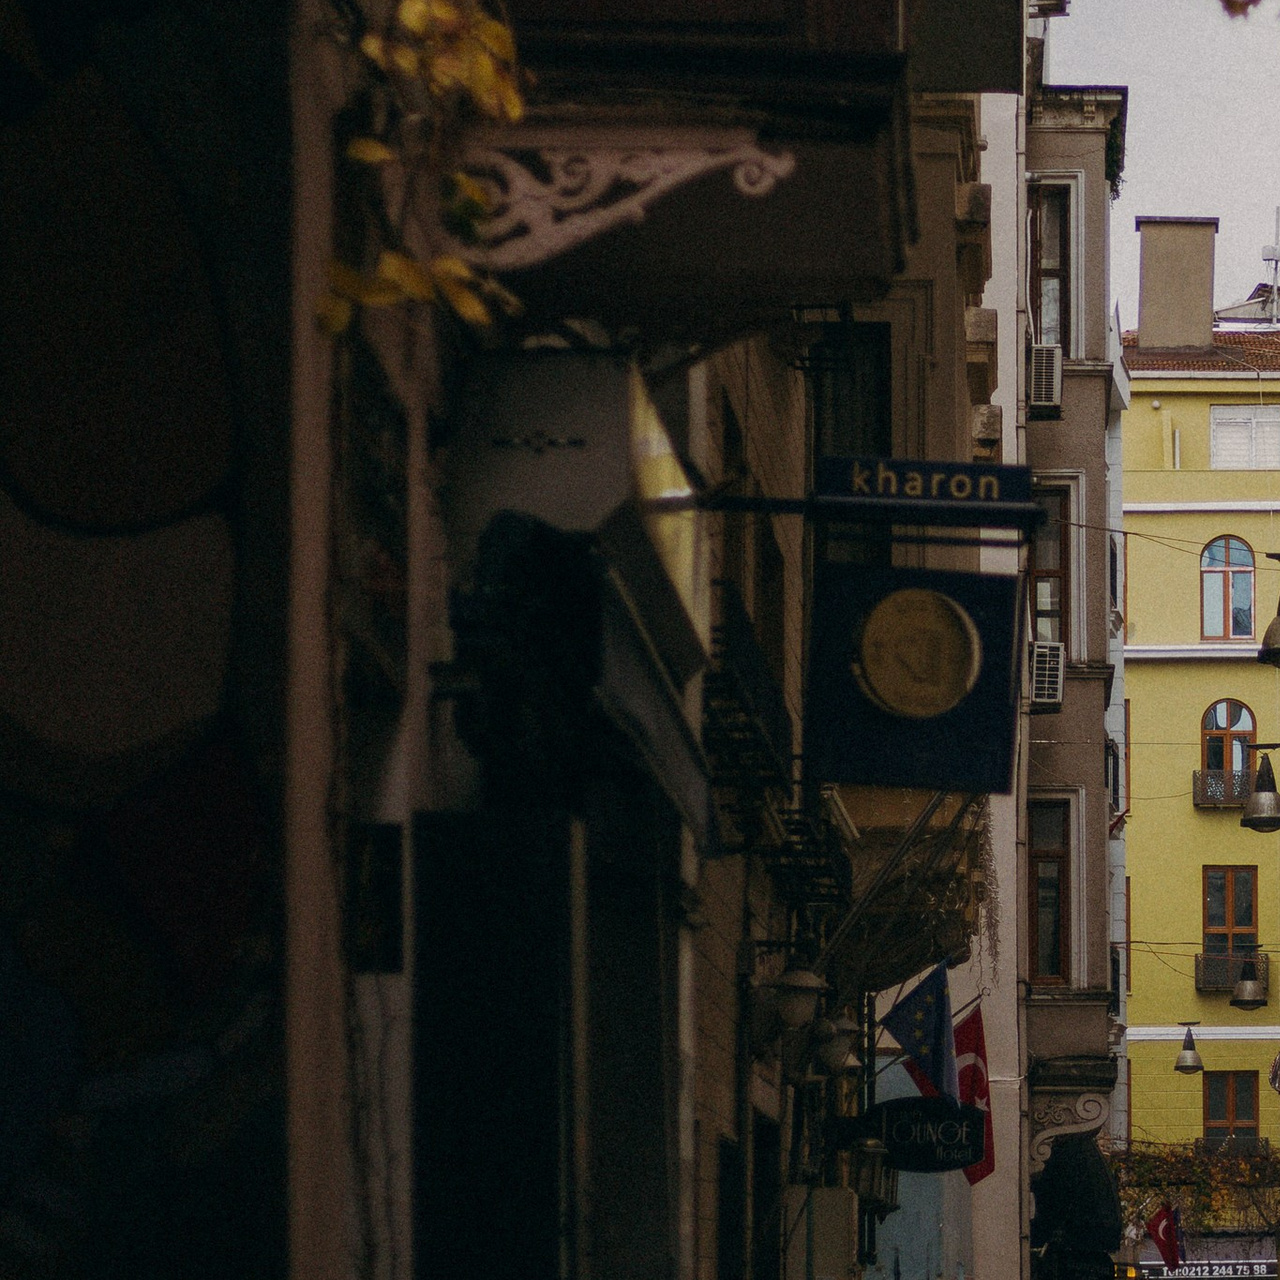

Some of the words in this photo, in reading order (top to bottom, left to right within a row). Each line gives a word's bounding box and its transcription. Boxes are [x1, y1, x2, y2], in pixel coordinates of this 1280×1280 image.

[851, 460, 1001, 500] kharon
[1212, 1265, 1233, 1276] 244
[1236, 1265, 1250, 1275] 75
